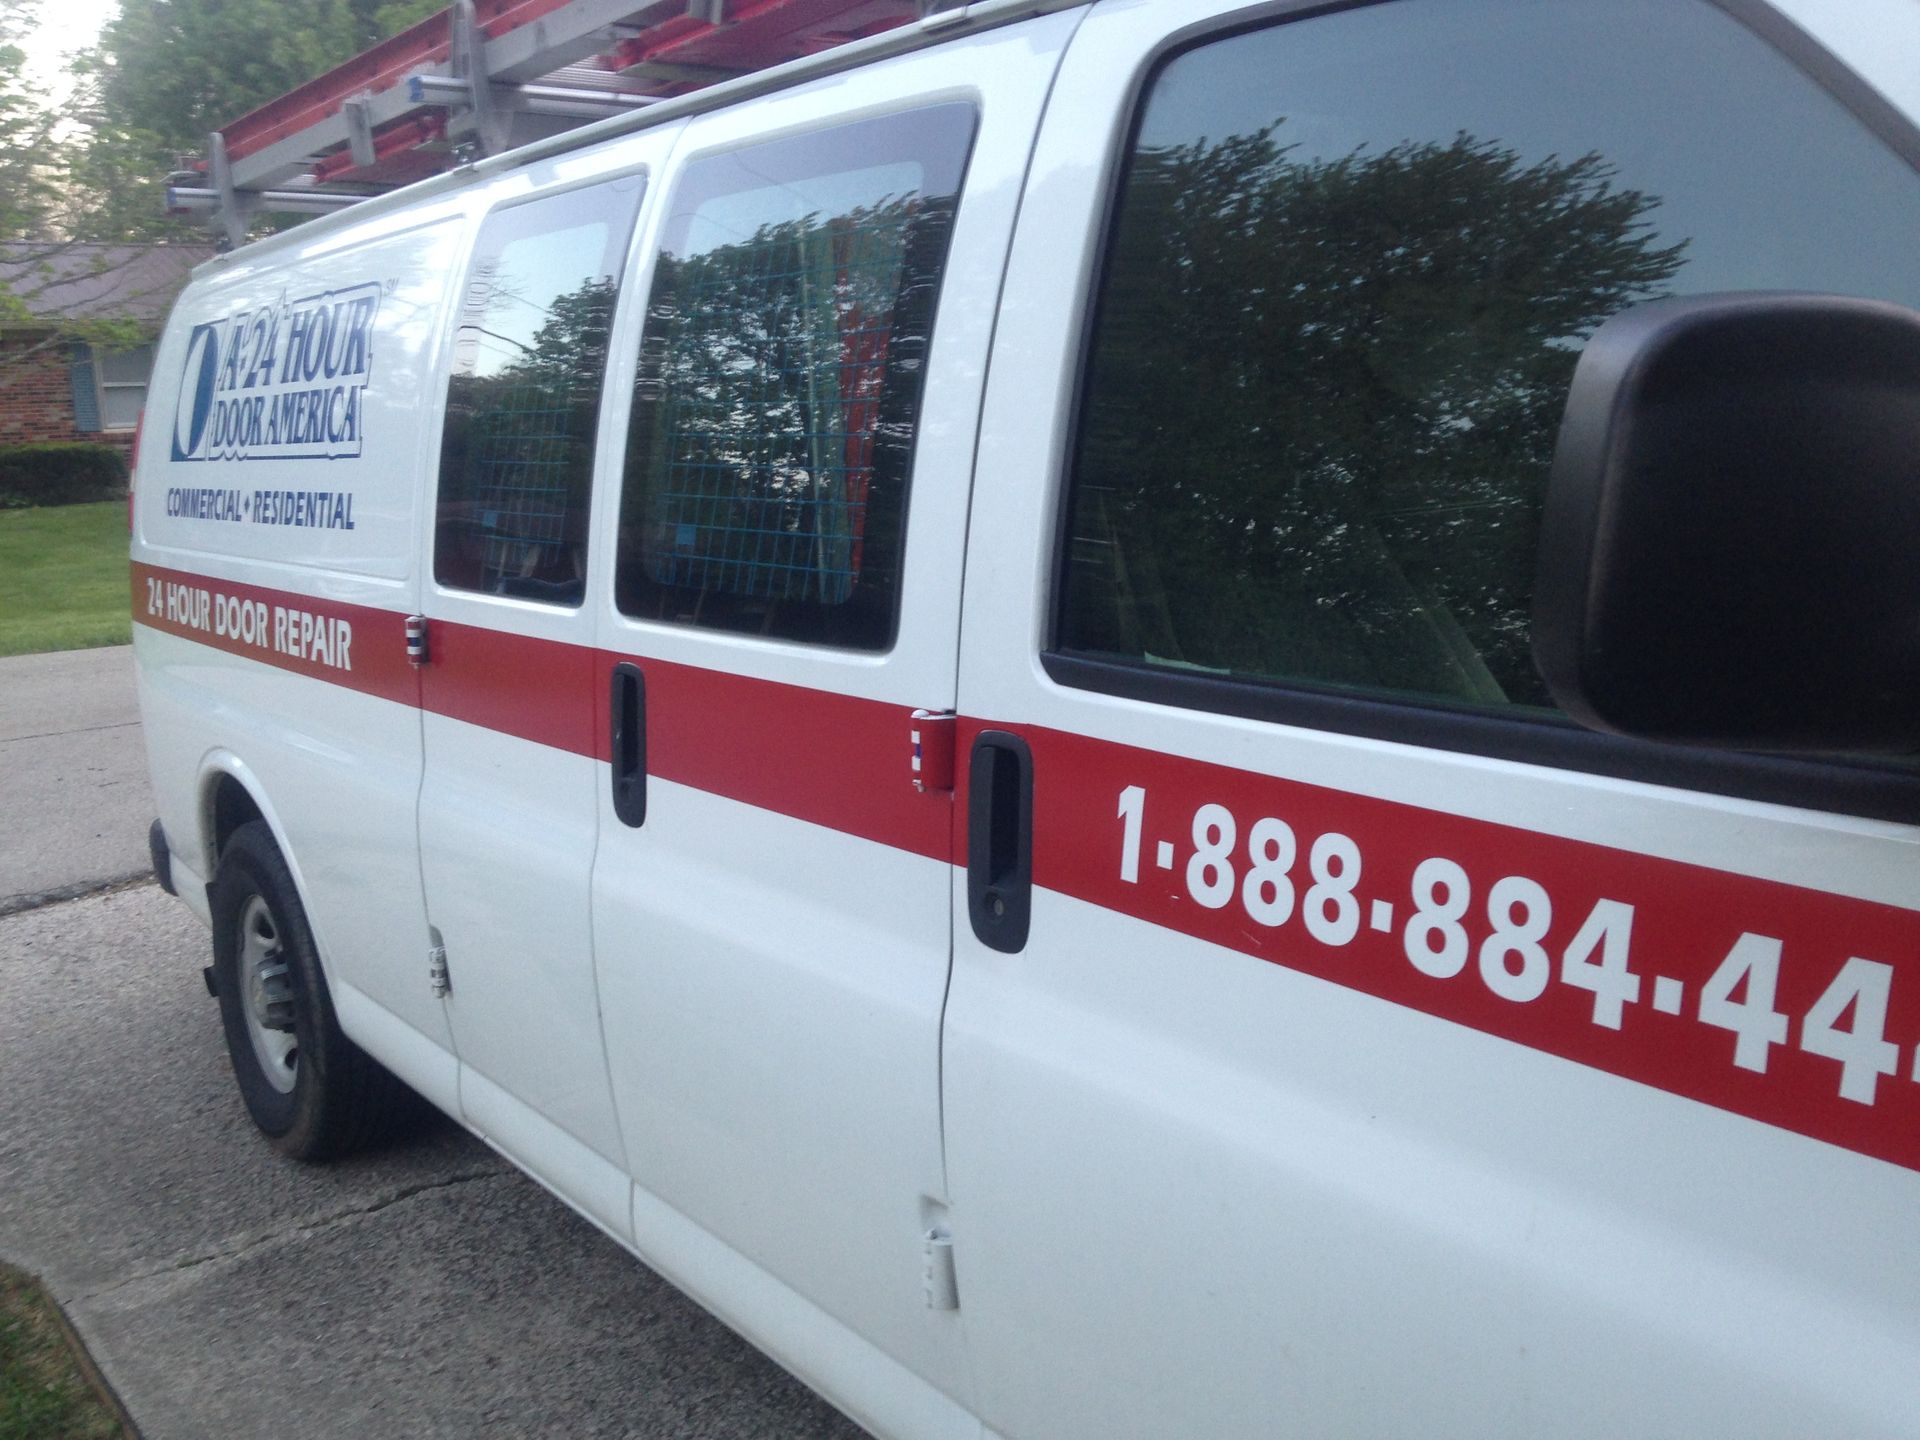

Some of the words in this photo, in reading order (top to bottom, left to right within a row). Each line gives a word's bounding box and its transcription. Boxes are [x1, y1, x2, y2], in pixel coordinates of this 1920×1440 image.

[281, 296, 375, 383] HOUR
[212, 396, 264, 447] DOOR
[264, 385, 358, 445] AMERICA
[167, 487, 242, 521] COMMERCIAL
[252, 490, 355, 530] RESIDENTIAL
[147, 577, 163, 618] 24
[166, 582, 210, 632] HOUR
[214, 593, 268, 648] DOOR
[274, 606, 351, 671] REPAIR
[1116, 785, 1920, 1106] 1-888-884-44
